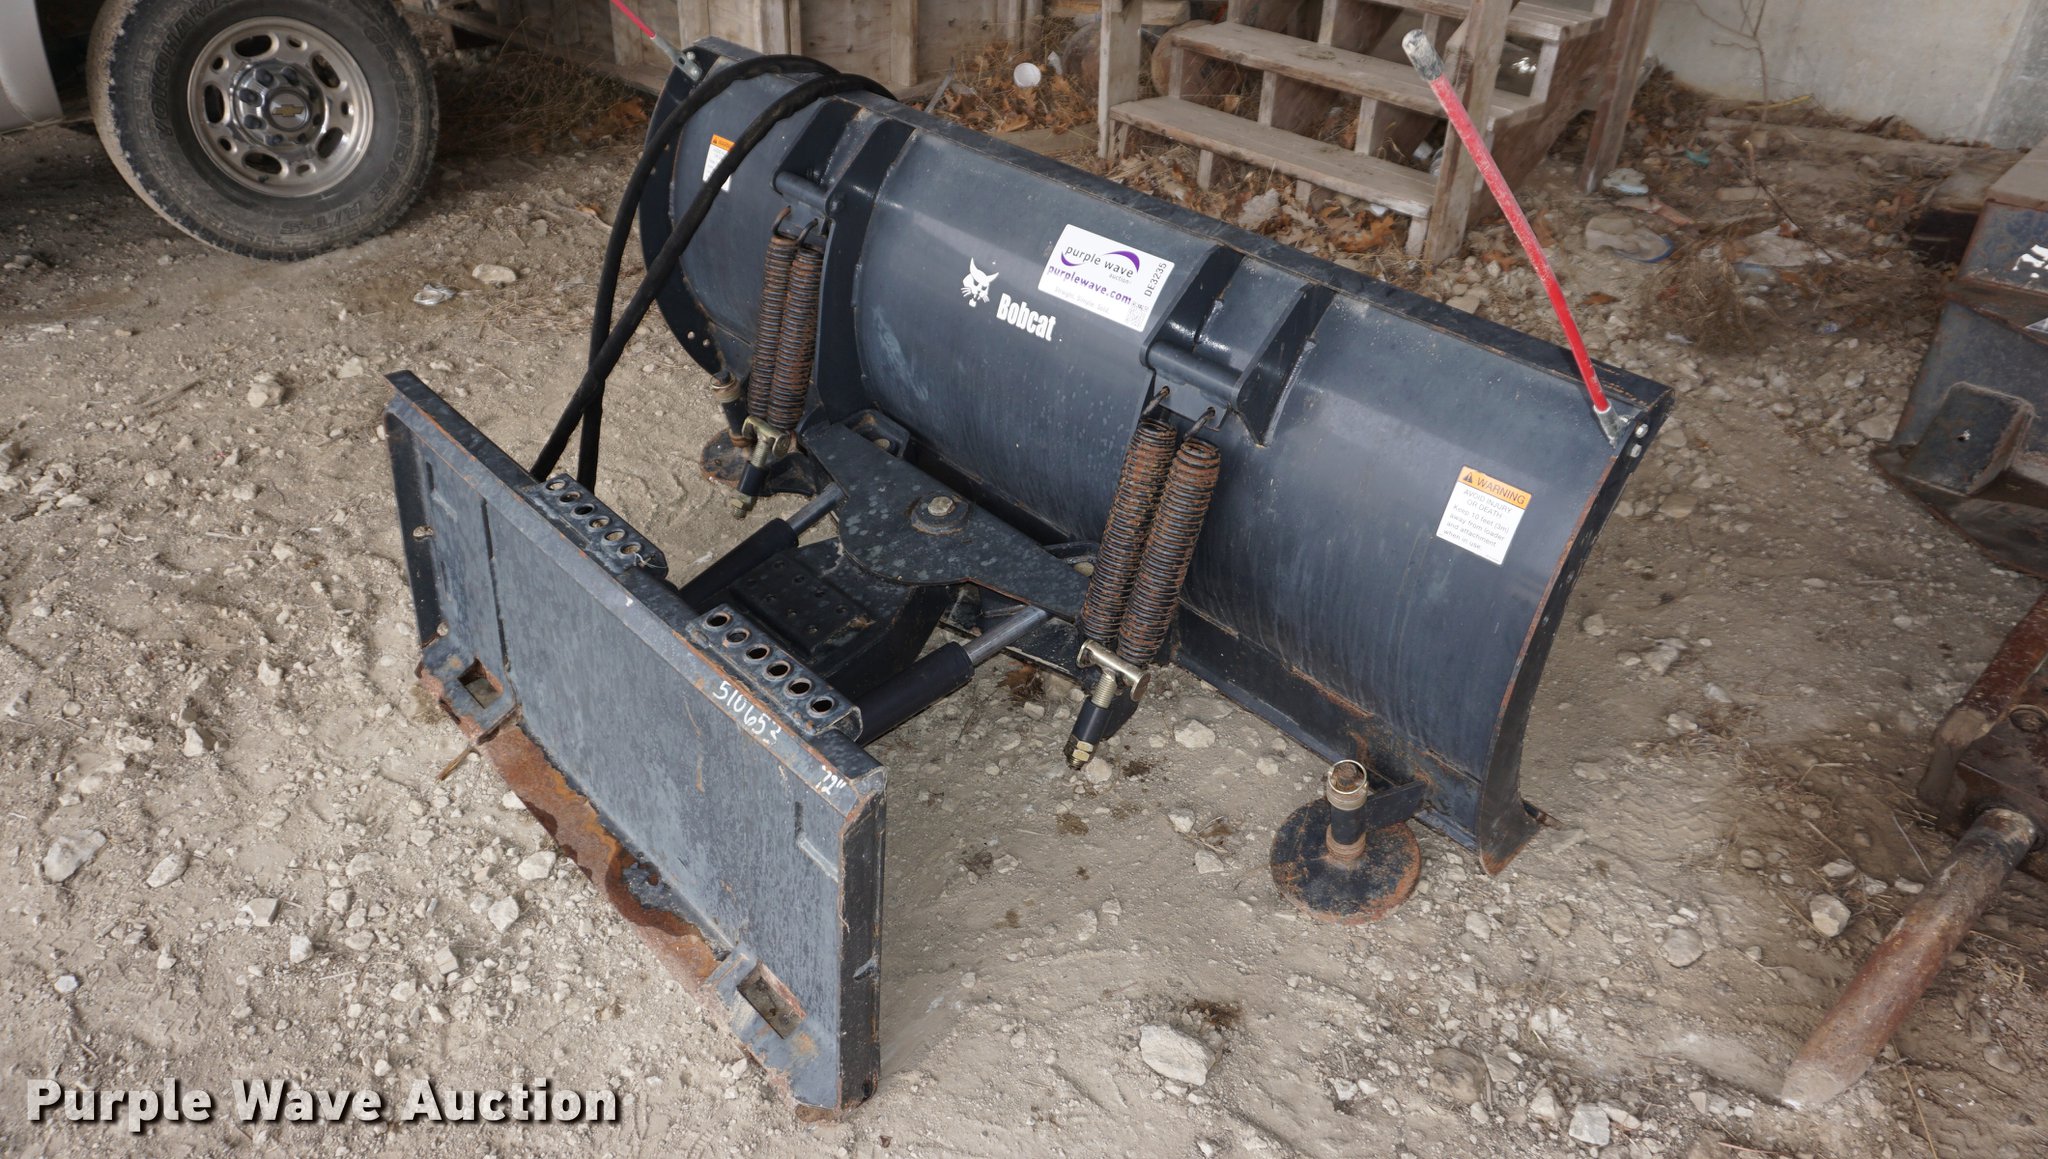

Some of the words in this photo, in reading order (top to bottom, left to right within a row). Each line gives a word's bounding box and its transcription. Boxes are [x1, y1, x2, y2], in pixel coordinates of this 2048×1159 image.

[1064, 245, 1102, 267] purple
[1103, 260, 1134, 279] wave
[1047, 265, 1132, 305] purplewave.com
[1144, 262, 1167, 297] DE3235
[996, 292, 1057, 342] Bobcat
[1463, 488, 1486, 502] AVOID
[1486, 497, 1513, 514] INJURY
[1476, 477, 1526, 506] WARNING
[1453, 504, 1470, 516] Keep
[1472, 512, 1480, 520] 10
[1480, 516, 1494, 527] feet
[1466, 498, 1478, 508] OR
[1478, 503, 1503, 519] DEATH
[1443, 528, 1461, 541] when
[1446, 521, 1459, 531] and
[1460, 527, 1497, 547] attachment
[1449, 514, 1466, 525] away
[1467, 518, 1483, 531] from
[1483, 526, 1505, 541] loader
[712, 680, 782, 745] 510653
